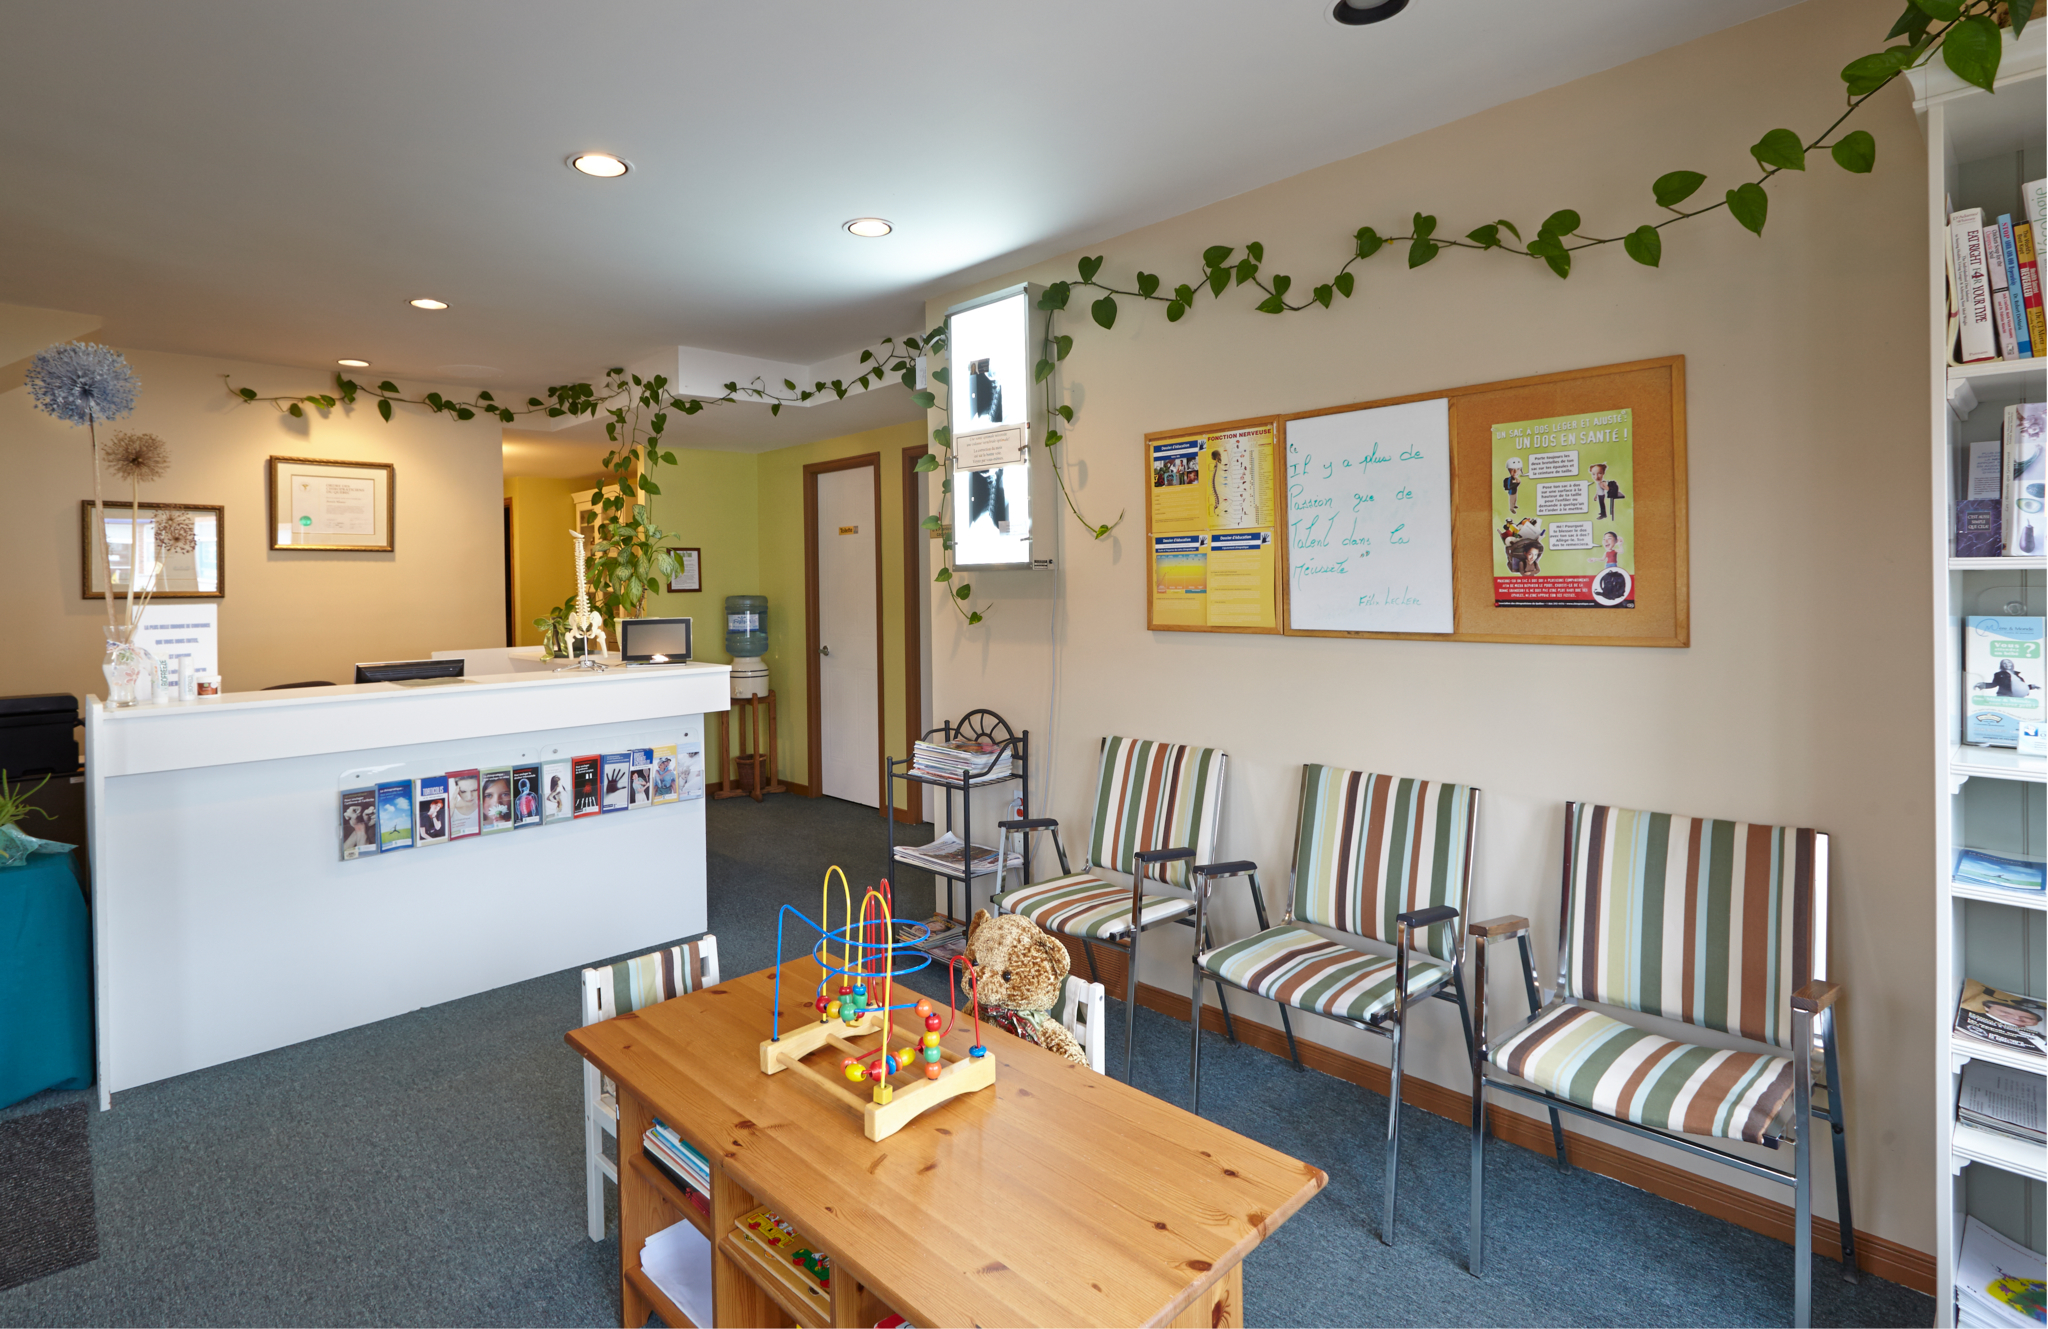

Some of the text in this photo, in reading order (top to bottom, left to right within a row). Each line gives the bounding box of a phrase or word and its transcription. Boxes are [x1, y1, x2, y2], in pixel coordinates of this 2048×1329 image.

[1967, 230, 1980, 242] EAT
[2002, 222, 2010, 238] STOP
[1968, 245, 1982, 266] RIGHT
[2020, 267, 2033, 297] REVEALED
[1973, 285, 1985, 306] YOUR
[1974, 305, 1987, 323] TYPE
[1208, 429, 1272, 442] FONCTION NERVEUSE
[1497, 431, 1506, 439] UN
[1509, 428, 1522, 438] SAC
[1535, 426, 1549, 434] DOS
[1553, 420, 1577, 432] LÉGER
[1581, 418, 1590, 428] ET
[1516, 437, 1530, 449] UN
[1534, 434, 1556, 448] DOS
[1561, 433, 1576, 446] EN
[1580, 429, 1620, 444] SANTÉ
[1290, 442, 1424, 479] Il y a plus de
[1289, 484, 1413, 513] Passion que de
[1342, 517, 1371, 546] dans
[1390, 523, 1410, 544] la
[2024, 643, 2036, 657] ?
[422, 786, 444, 796] TORTICOLIS
